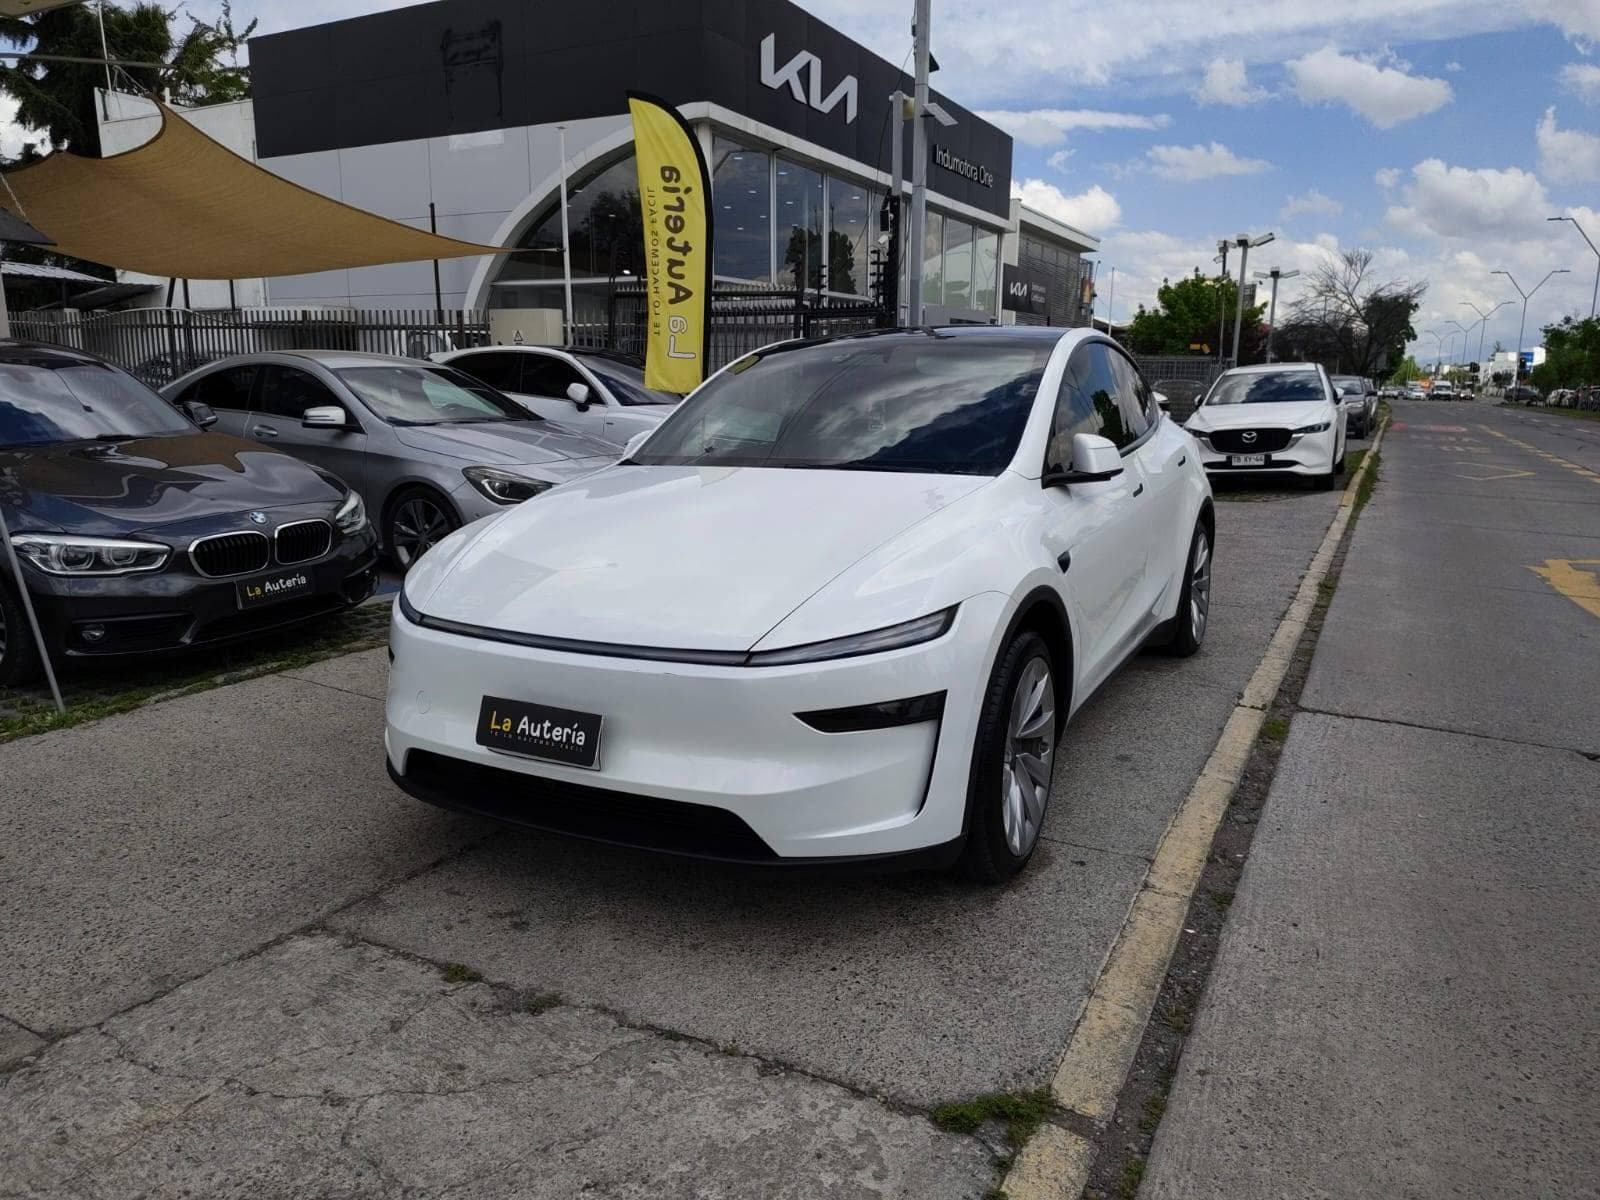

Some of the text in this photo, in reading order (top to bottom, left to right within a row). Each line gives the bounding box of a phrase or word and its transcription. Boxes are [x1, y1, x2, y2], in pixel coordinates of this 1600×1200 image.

[760, 32, 858, 124] KIA
[936, 144, 994, 188] Indumotora One
[1010, 282, 1027, 297] KIA
[246, 585, 262, 597] La
[490, 710, 586, 746] La Autería
